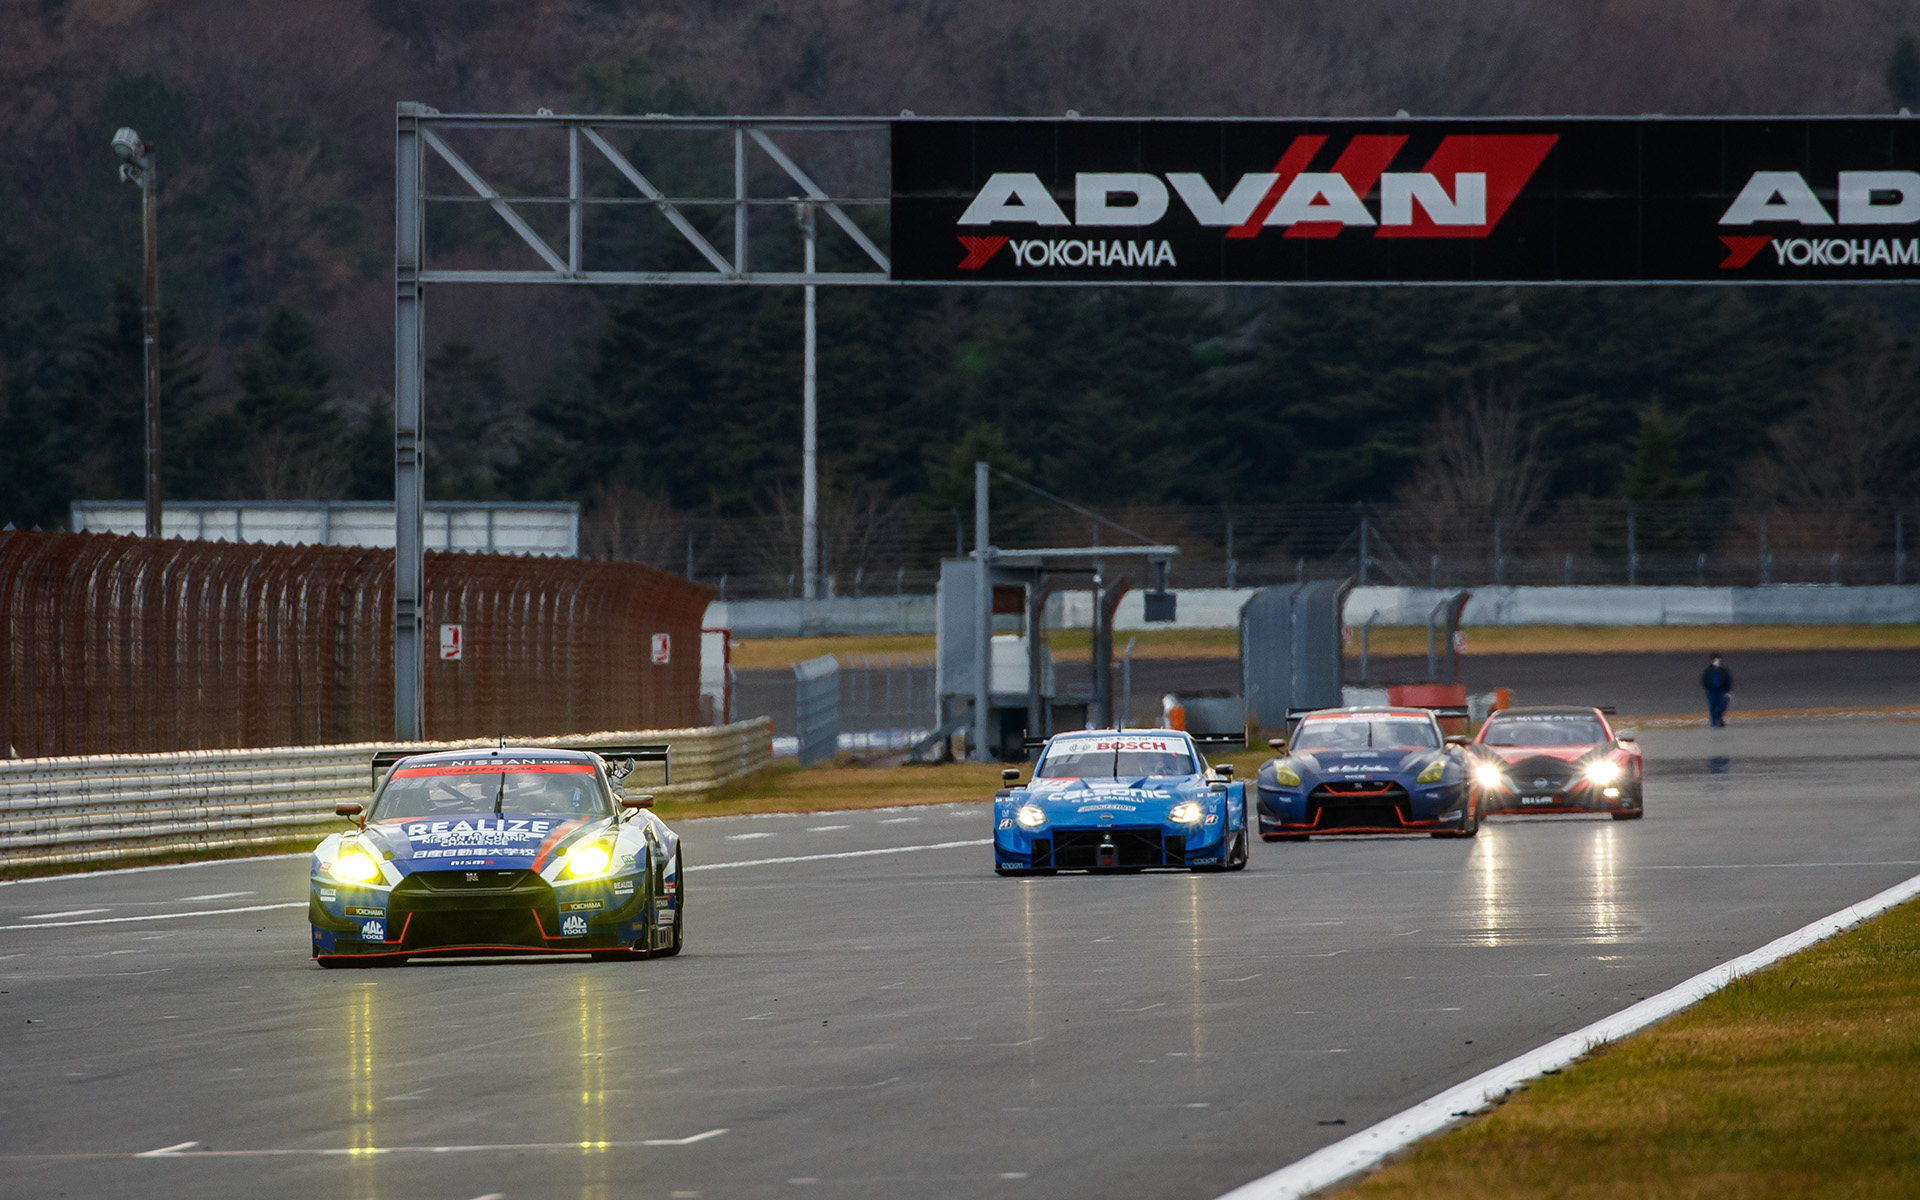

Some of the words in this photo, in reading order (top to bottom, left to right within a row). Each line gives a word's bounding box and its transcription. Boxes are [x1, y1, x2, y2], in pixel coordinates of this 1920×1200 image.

[956, 172, 1487, 226] ADVAN
[1009, 239, 1177, 267] YOKOHAMA
[1771, 238, 1920, 266] YOKOHAM
[1097, 741, 1167, 750] BOSCH
[451, 759, 536, 767] NISSAN
[1103, 795, 1145, 803] MARELLI
[408, 819, 550, 836] REALIZE
[440, 839, 509, 847] CHALLENGE
[570, 902, 602, 910] YOKOHAMA
[361, 920, 384, 935] MAC
[562, 916, 587, 930] MAC
